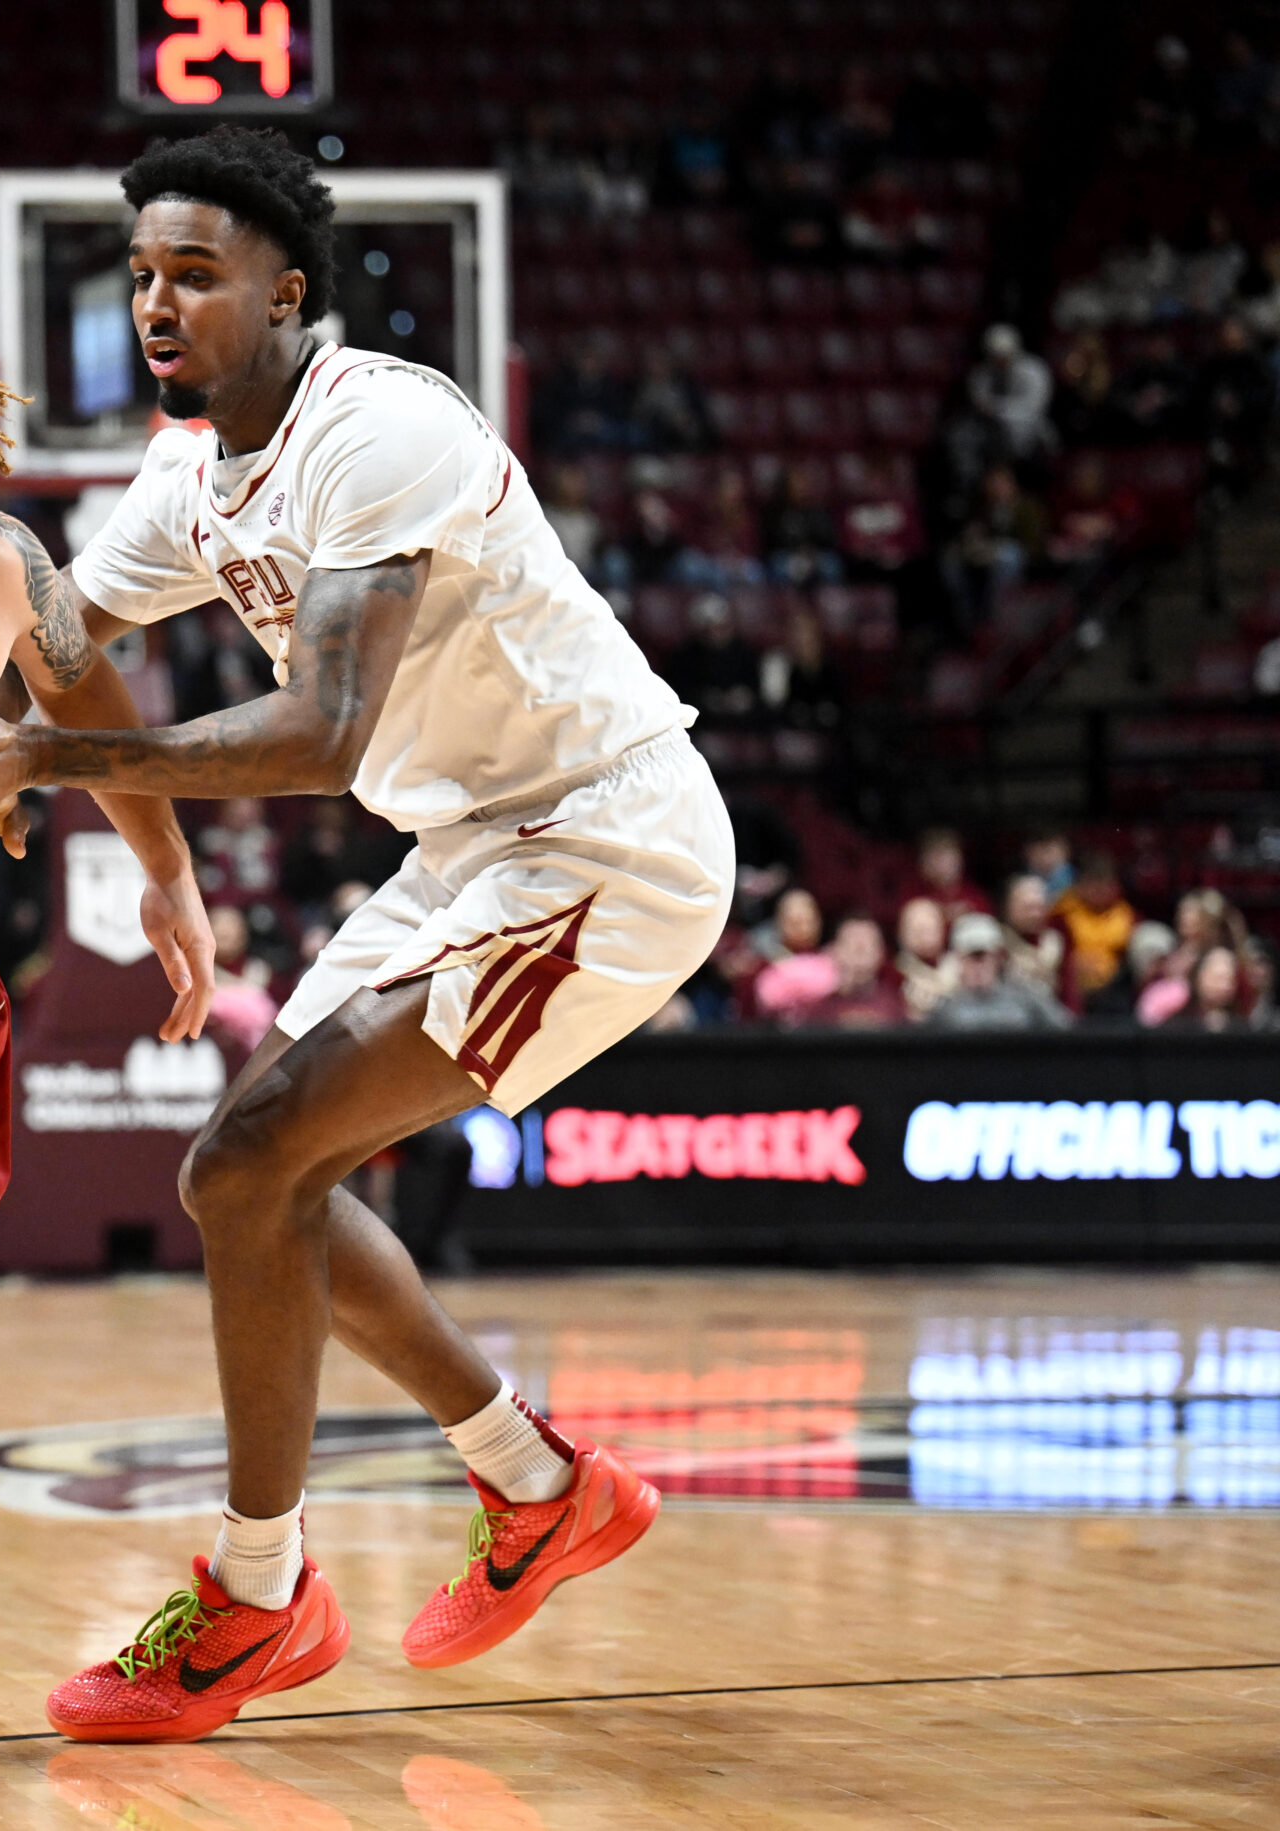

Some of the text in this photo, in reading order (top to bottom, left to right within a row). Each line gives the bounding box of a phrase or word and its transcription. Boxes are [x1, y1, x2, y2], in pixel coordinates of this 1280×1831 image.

[156, 0, 290, 104] 24
[544, 1105, 866, 1187] SEATGEEK
[903, 1099, 1280, 1181] OFFICIAL TIC
